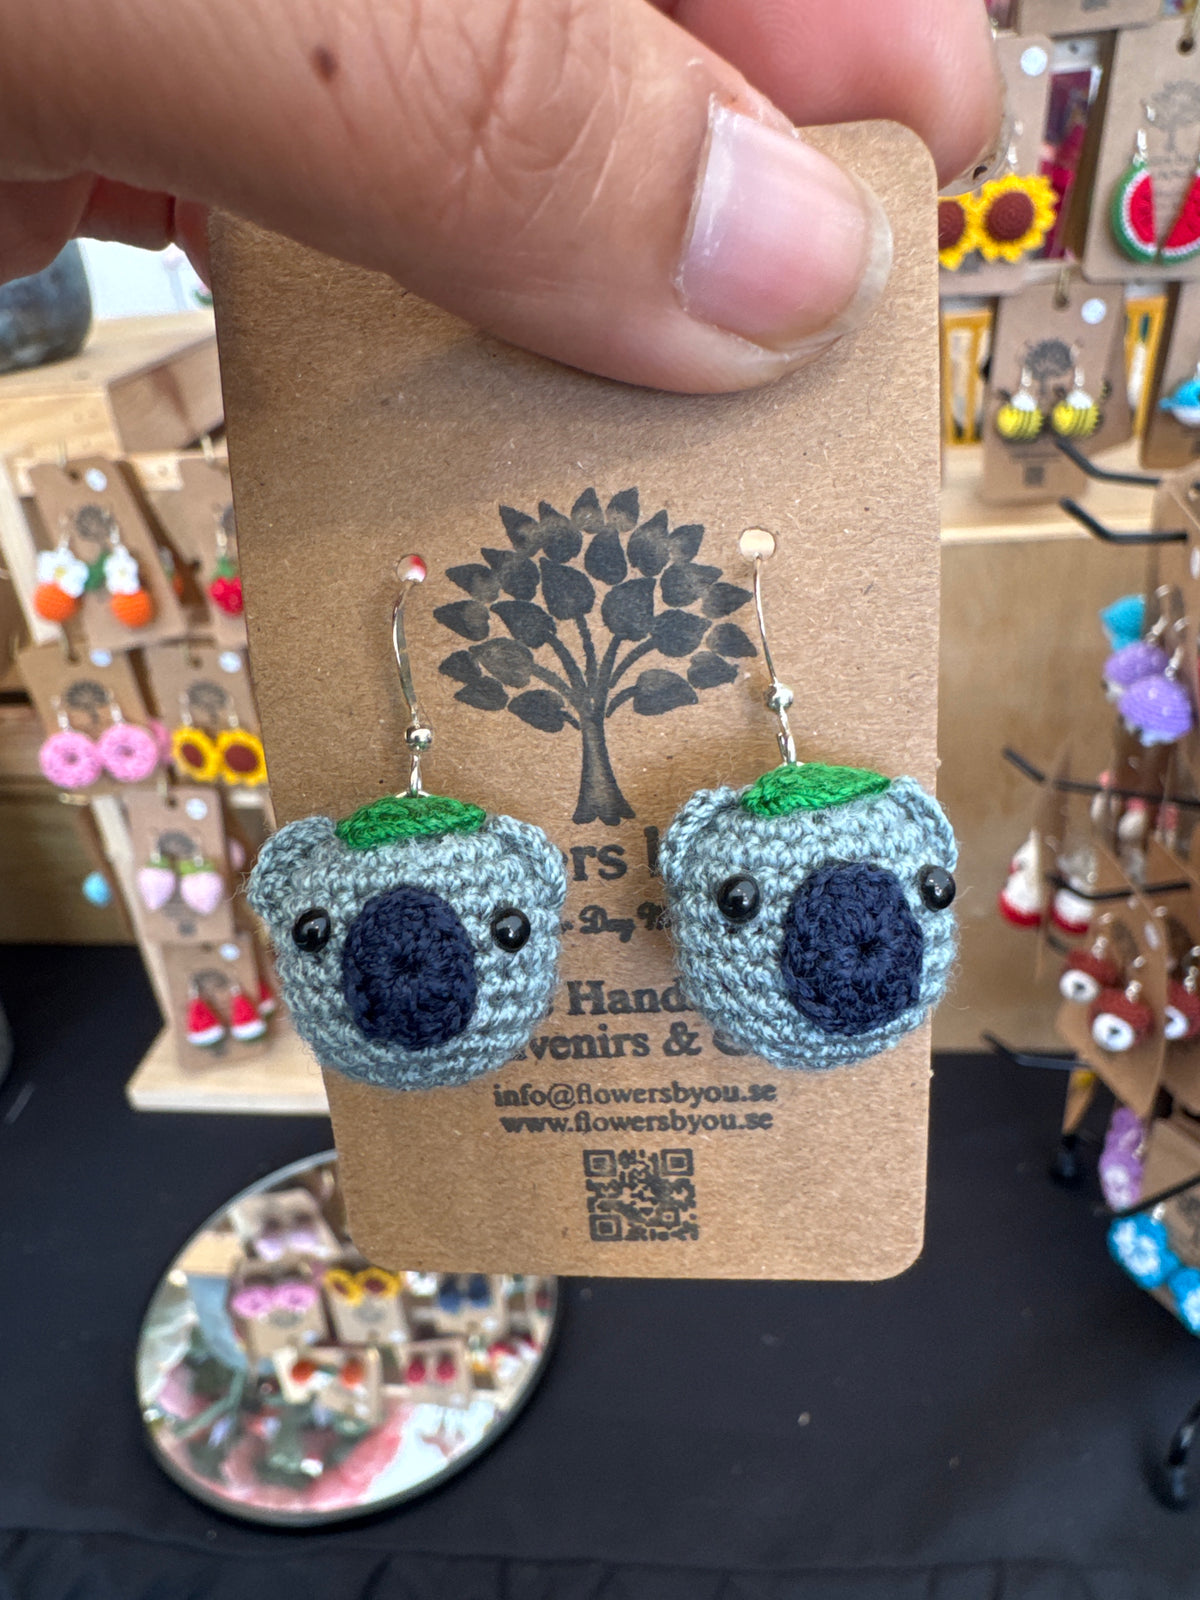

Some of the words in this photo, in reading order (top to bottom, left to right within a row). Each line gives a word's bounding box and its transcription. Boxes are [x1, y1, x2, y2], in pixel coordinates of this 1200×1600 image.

[562, 844, 628, 881] rs
[662, 1021, 702, 1057] &
[493, 1080, 777, 1110] info@flowersbyou.se
[500, 1109, 773, 1135] www.flowersbyou.se
